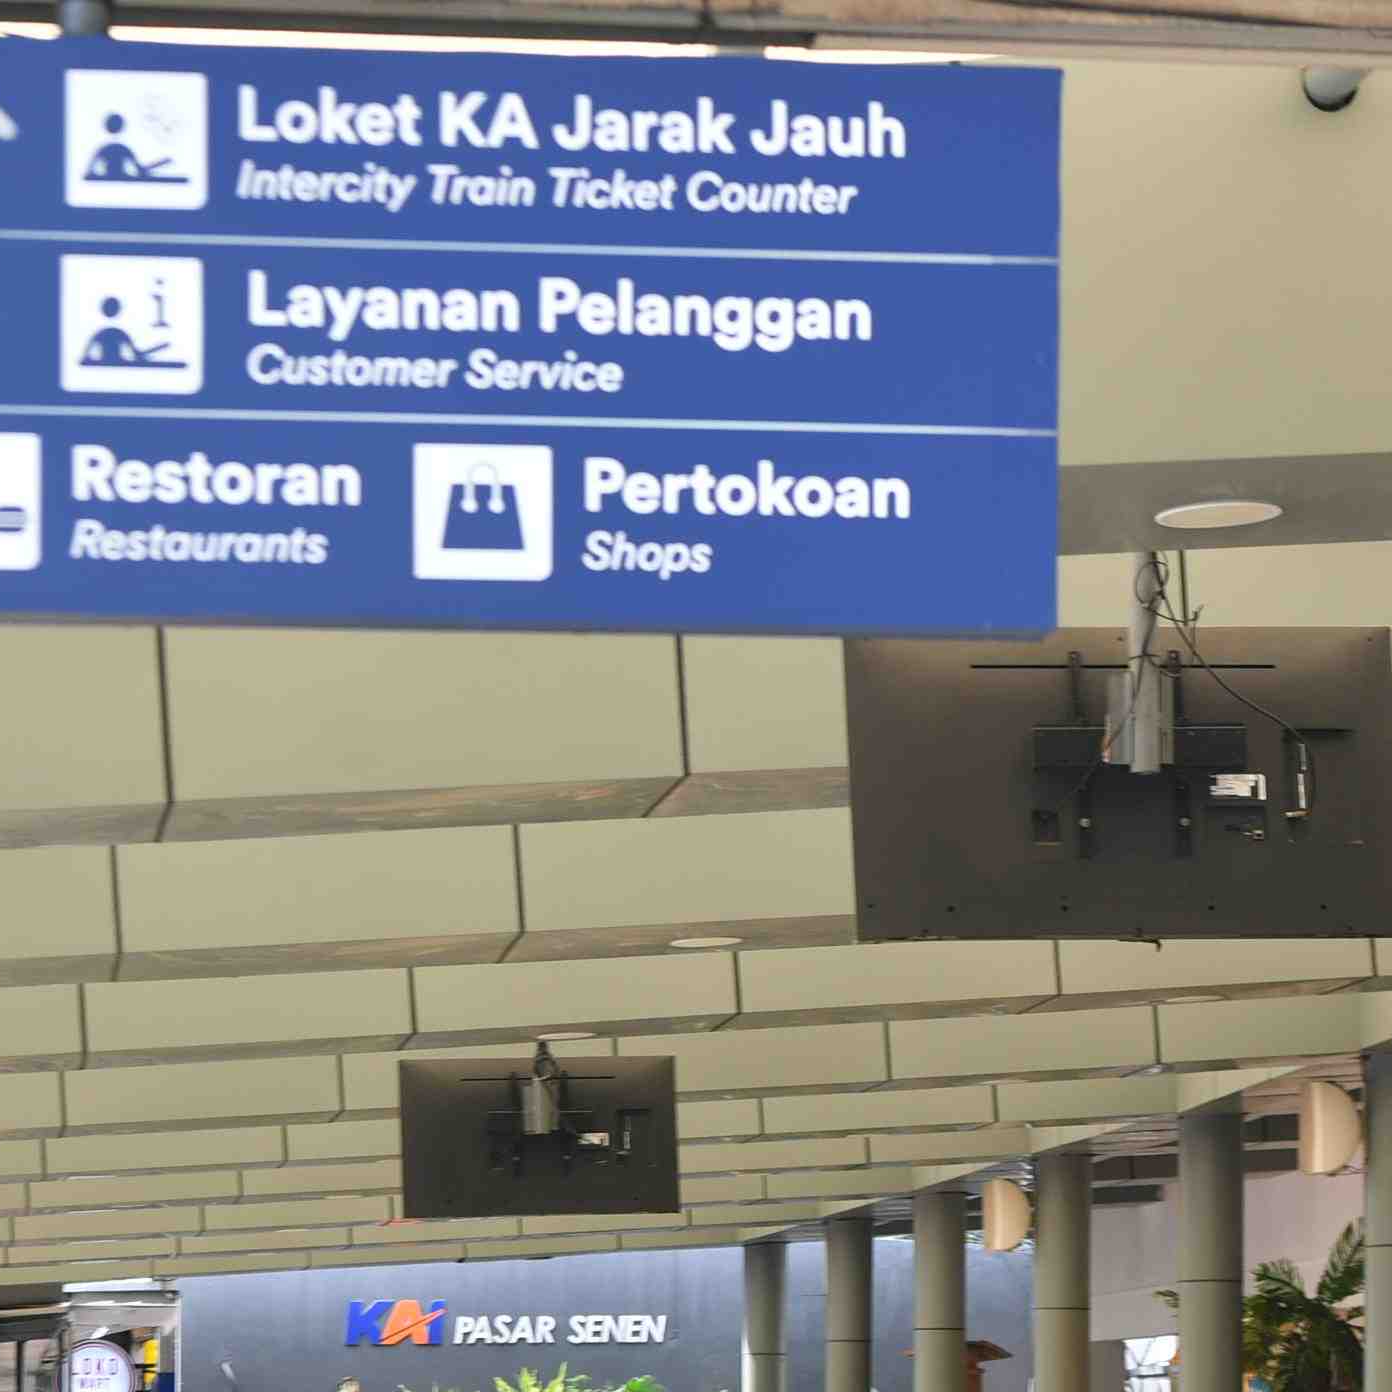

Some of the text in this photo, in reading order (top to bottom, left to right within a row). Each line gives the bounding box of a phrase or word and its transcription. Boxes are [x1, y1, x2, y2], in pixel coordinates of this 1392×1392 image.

[239, 85, 905, 157] Loket KA Jarak Jauh
[237, 159, 858, 214] Intercity Train Ticket Counter
[248, 270, 871, 352] Layanan Pelanggan
[247, 343, 624, 392] Customer Service
[72, 445, 361, 506] Restoran
[585, 457, 910, 518] Pertokoan
[70, 519, 328, 564] Restaurants
[582, 530, 712, 580] Shops
[345, 1299, 667, 1346] KAI PASAR SENEN
